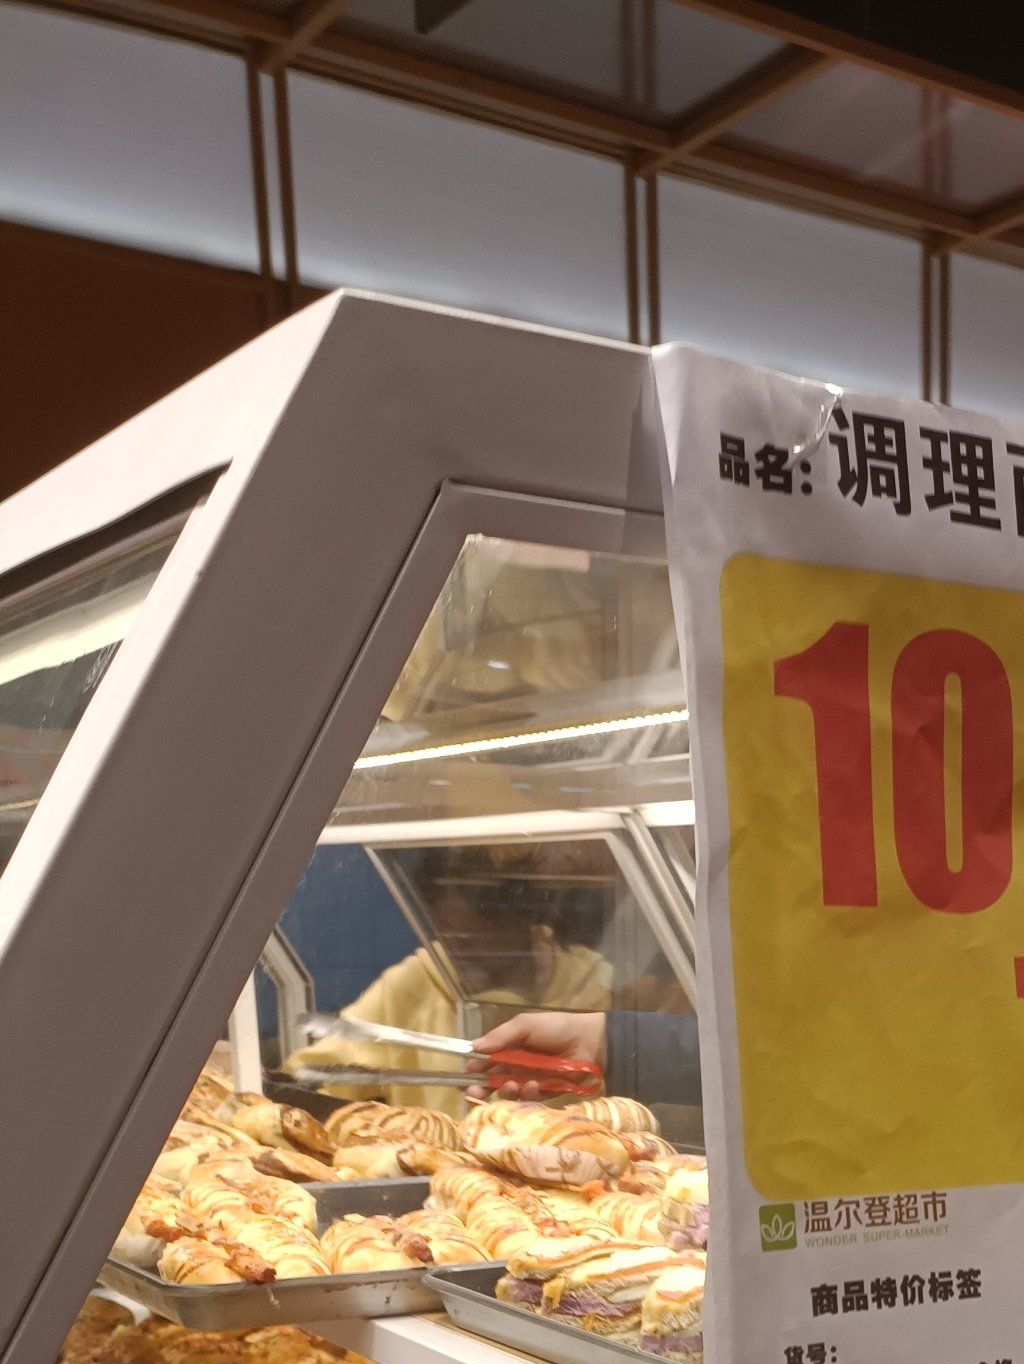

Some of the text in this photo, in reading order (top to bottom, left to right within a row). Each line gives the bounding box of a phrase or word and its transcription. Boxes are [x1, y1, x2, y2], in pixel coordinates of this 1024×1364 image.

[773, 620, 1014, 915] 10
[803, 1191, 948, 1233] 温尔登超市
[805, 1232, 858, 1248] WONDER
[810, 1268, 982, 1317] 商品特价标签
